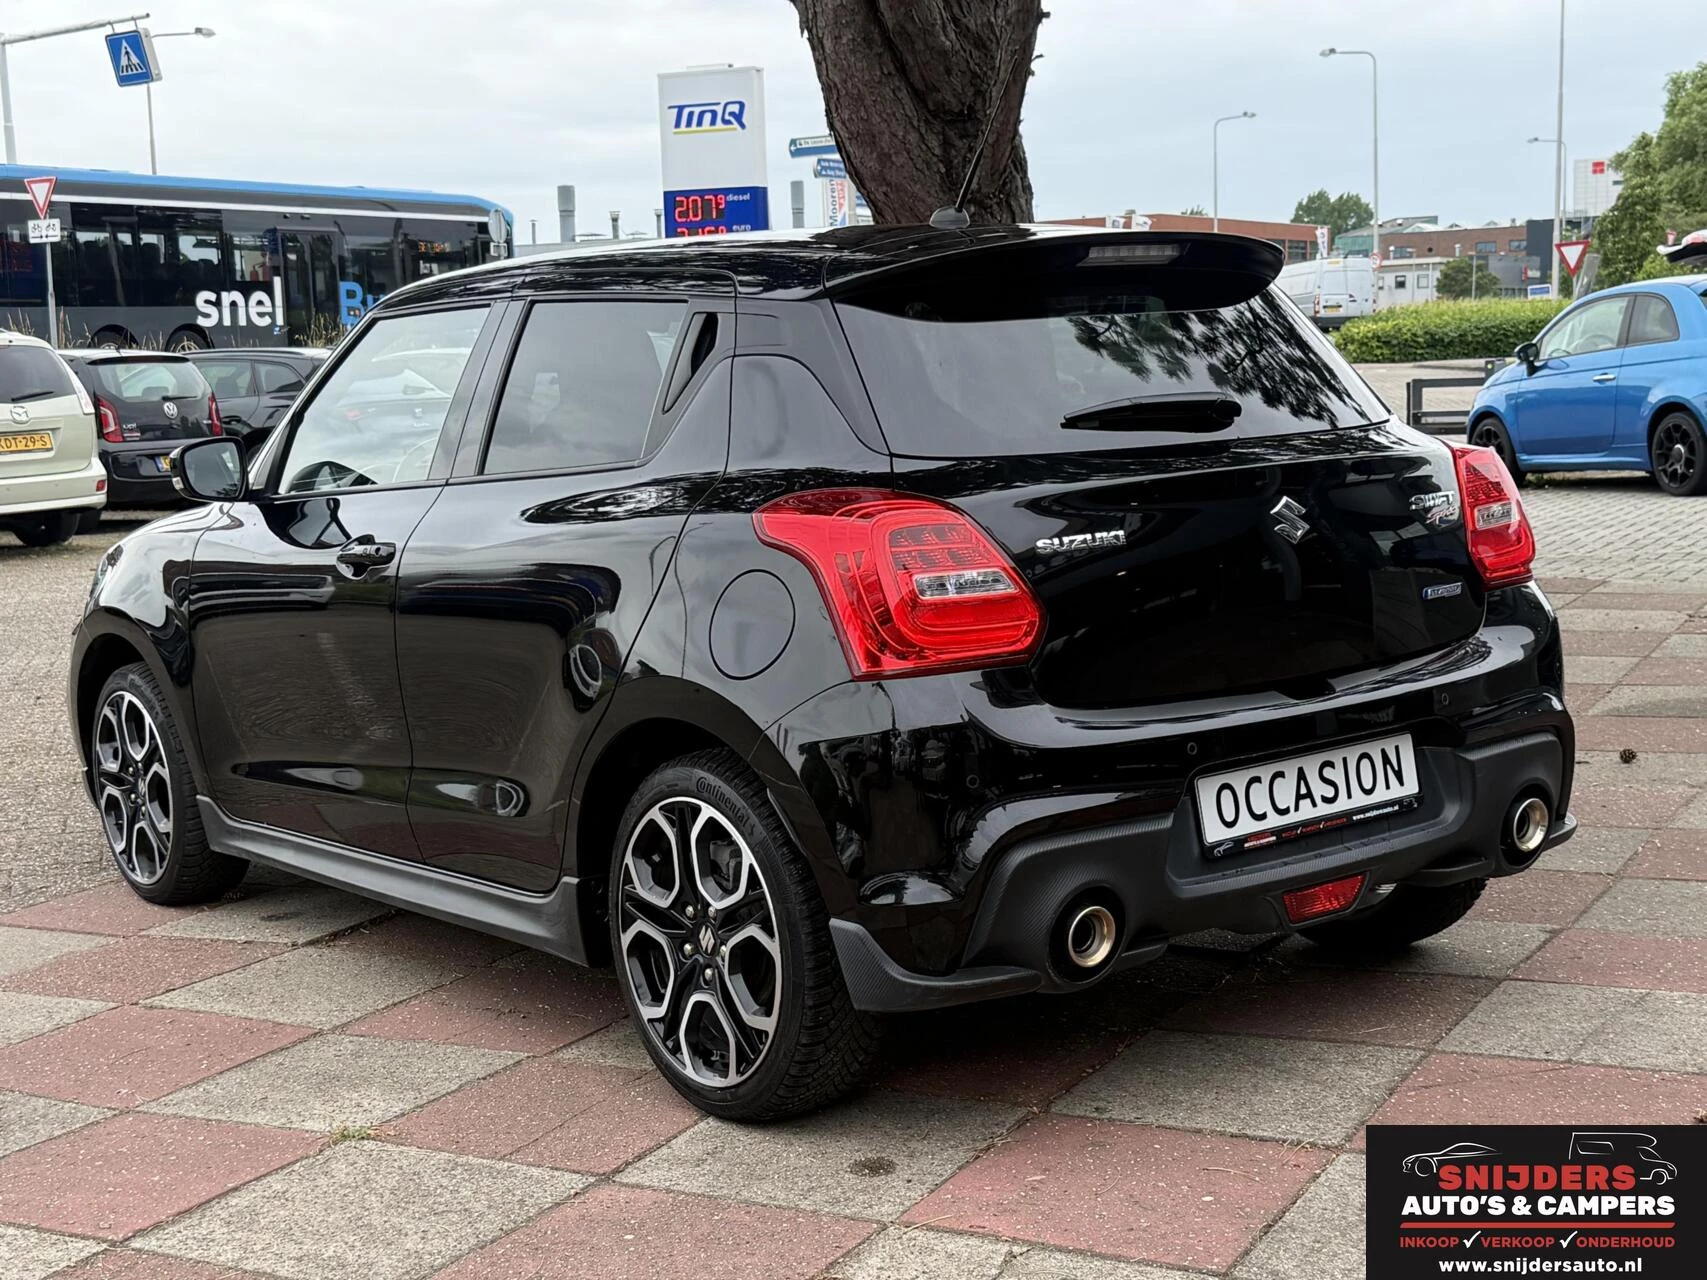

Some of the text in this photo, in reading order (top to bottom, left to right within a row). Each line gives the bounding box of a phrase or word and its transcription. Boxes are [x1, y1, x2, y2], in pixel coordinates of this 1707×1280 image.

[726, 192, 751, 202] diesel
[732, 224, 752, 232] euro
[195, 276, 284, 327] snel
[1408, 491, 1455, 511] SWIFT
[1035, 529, 1126, 555] SUZUKI
[1215, 744, 1405, 829] OCCASION
[696, 776, 750, 828] Continental
